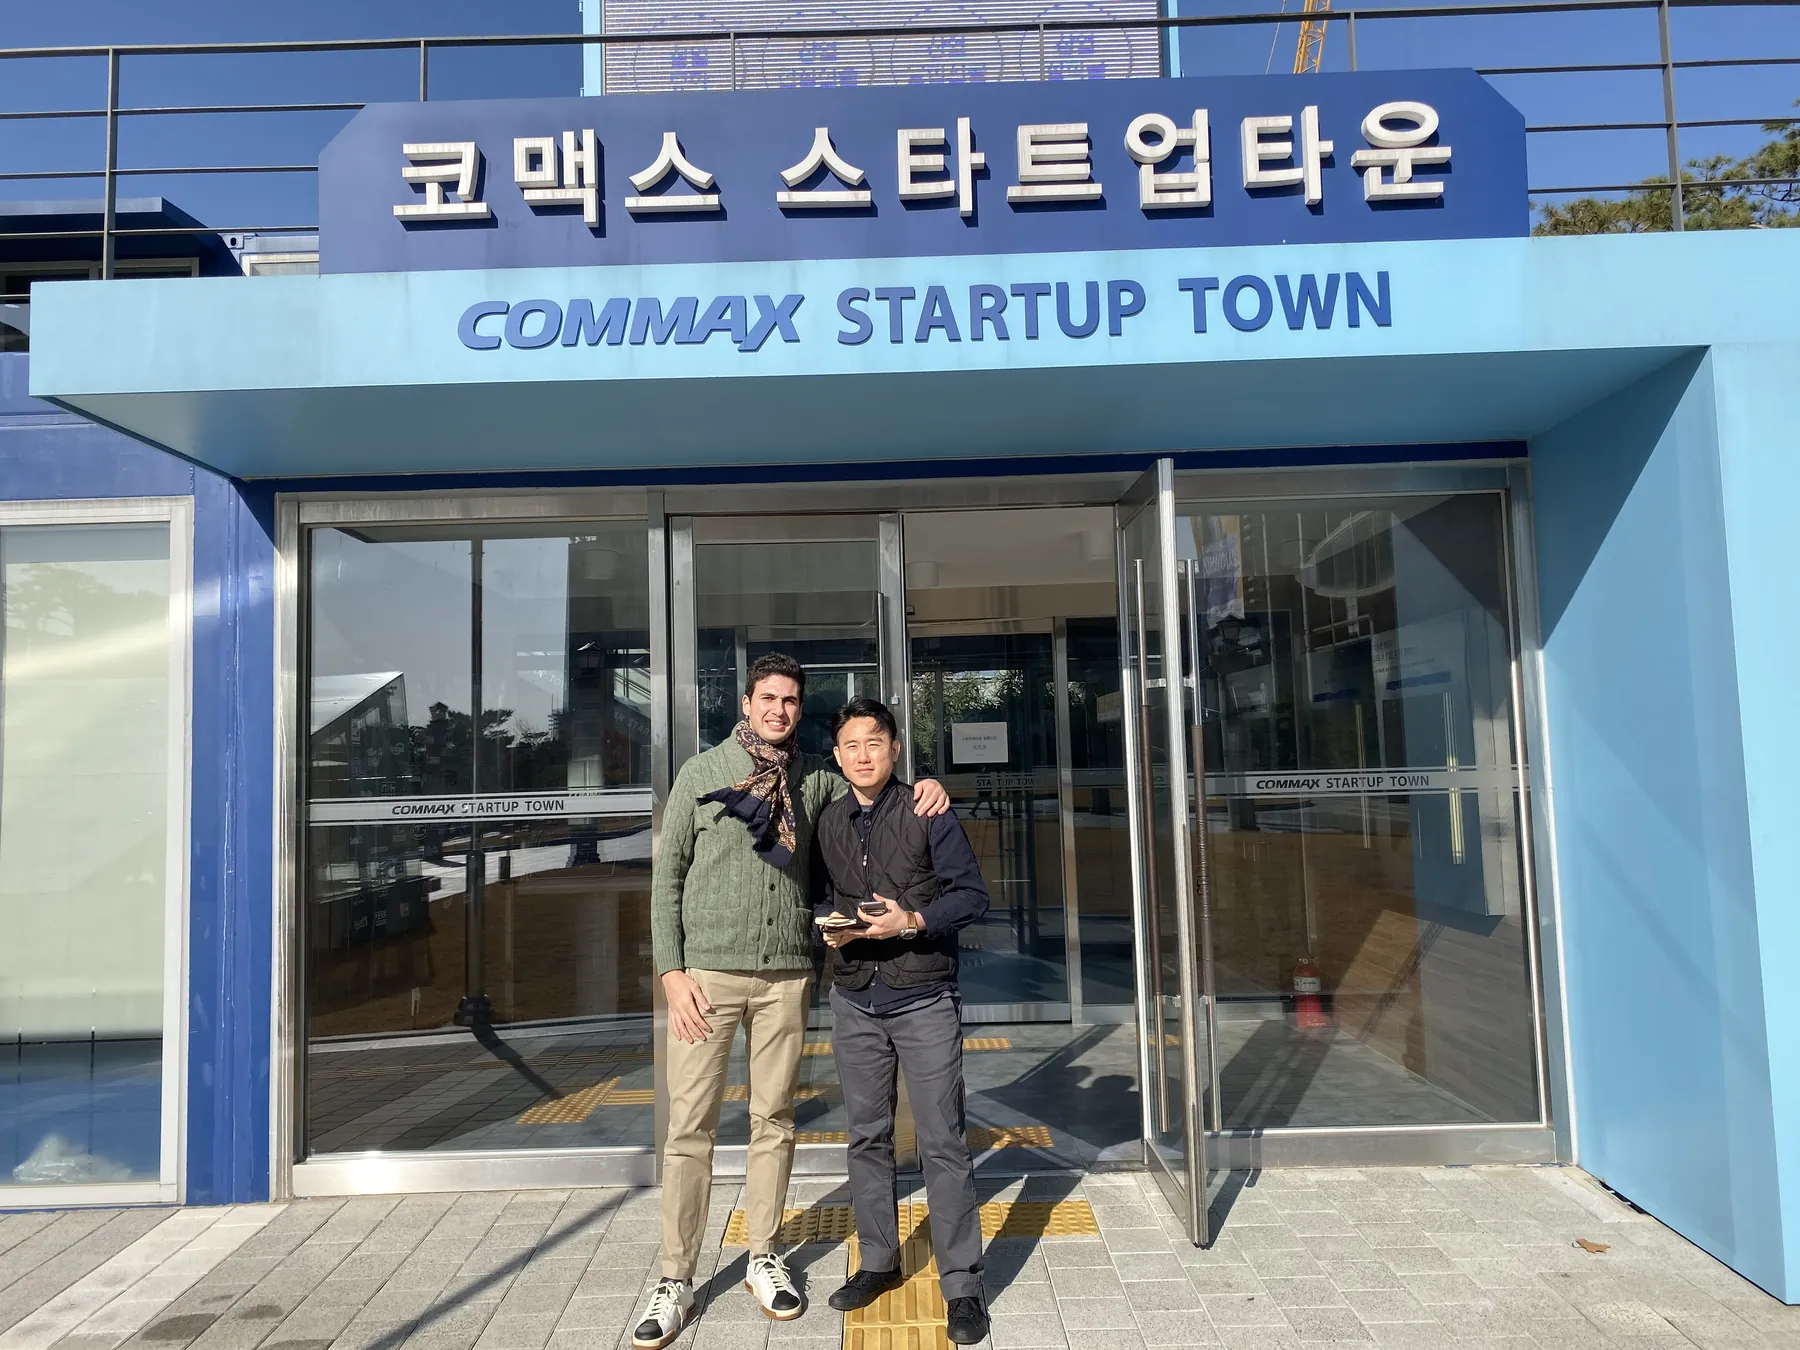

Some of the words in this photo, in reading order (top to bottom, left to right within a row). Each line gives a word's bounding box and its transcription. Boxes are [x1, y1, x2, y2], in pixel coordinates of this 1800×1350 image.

[393, 128, 722, 228] 코맥스
[776, 100, 1453, 218] 스타트업타운
[458, 294, 805, 354] COMMAX
[836, 280, 1146, 346] STARTUP
[1178, 270, 1391, 335] TOWN
[977, 779, 1013, 787] STATP
[1016, 777, 1041, 786] TOW
[1256, 778, 1320, 790] COMMAX
[1326, 776, 1384, 789] STARTUP
[1390, 775, 1429, 787] TOWN
[392, 804, 455, 815] COMMAX
[461, 801, 519, 814] STARTUP
[525, 800, 564, 811] TOWN
